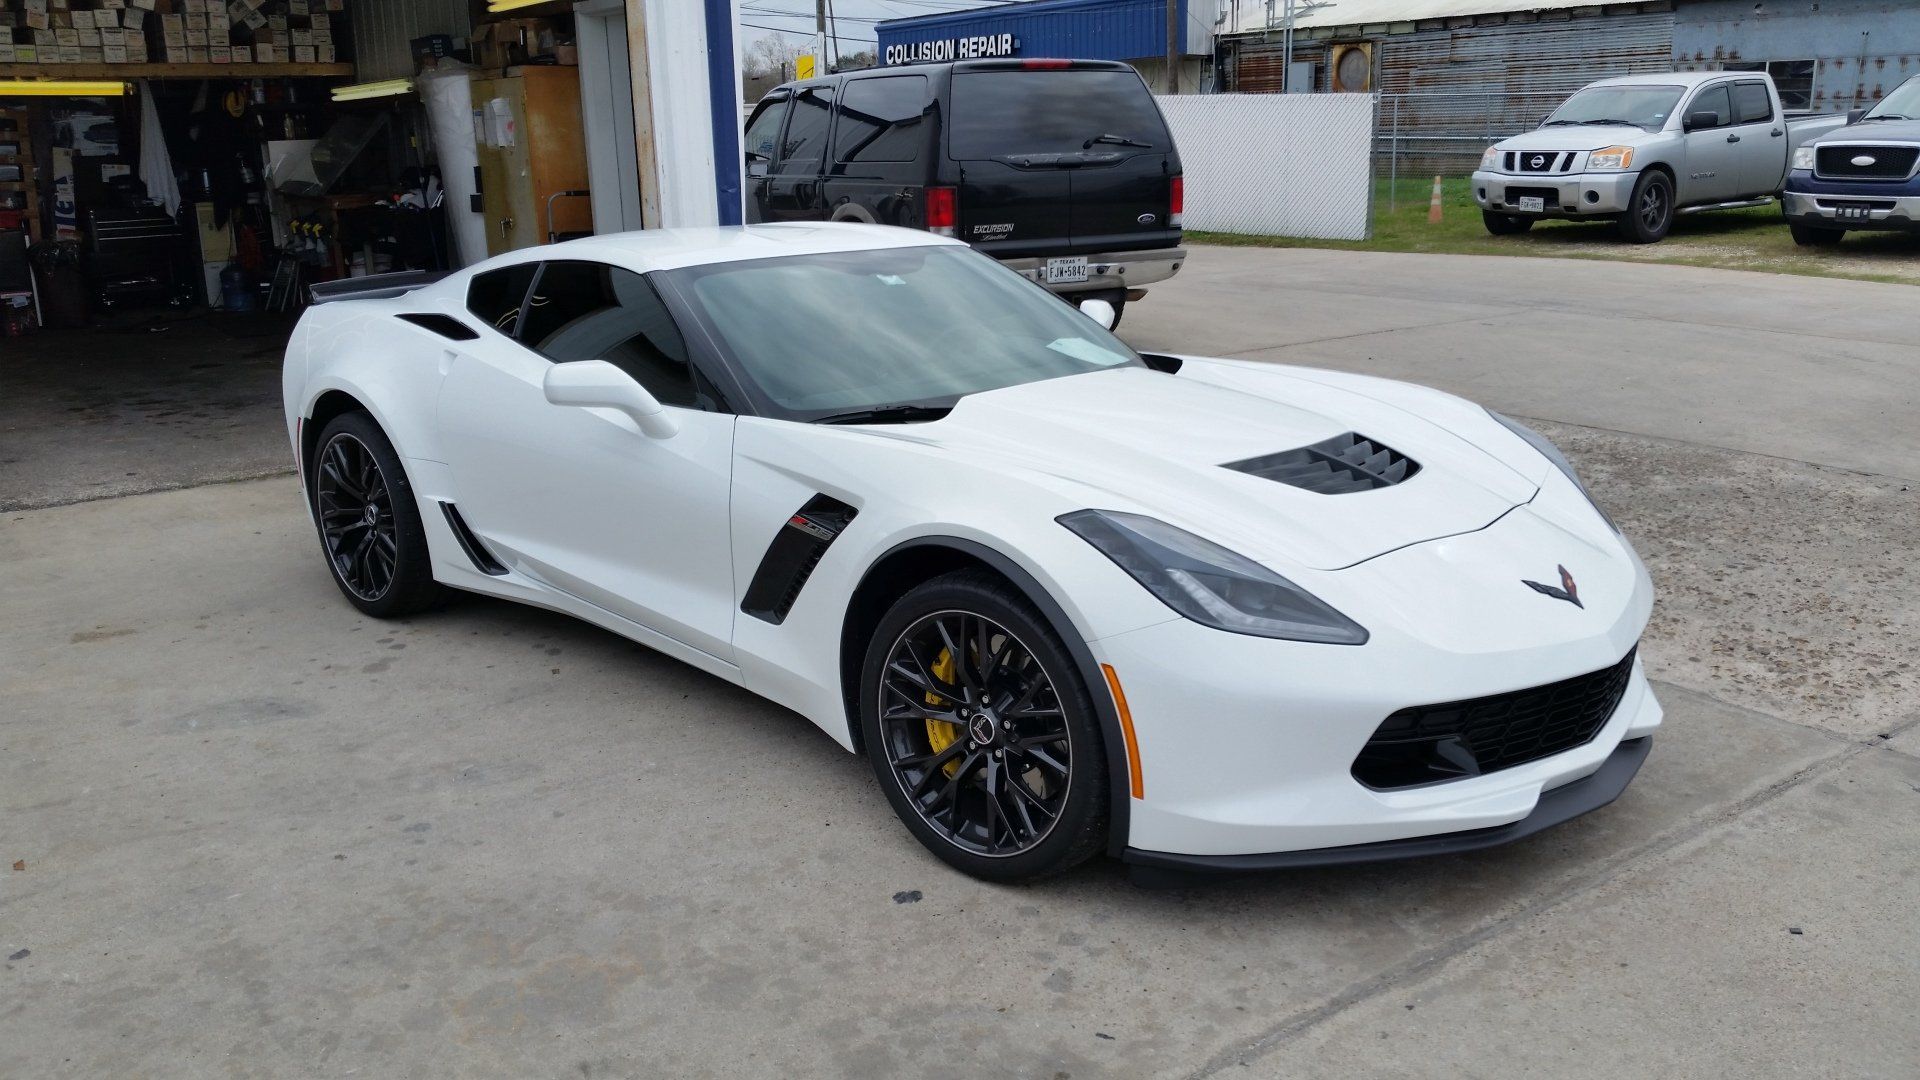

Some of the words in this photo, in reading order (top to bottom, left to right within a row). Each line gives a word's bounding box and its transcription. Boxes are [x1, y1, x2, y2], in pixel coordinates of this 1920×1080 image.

[886, 39, 955, 64] COLLISION
[959, 33, 1012, 58] REPAIR
[973, 223, 1014, 234] EXCURSION
